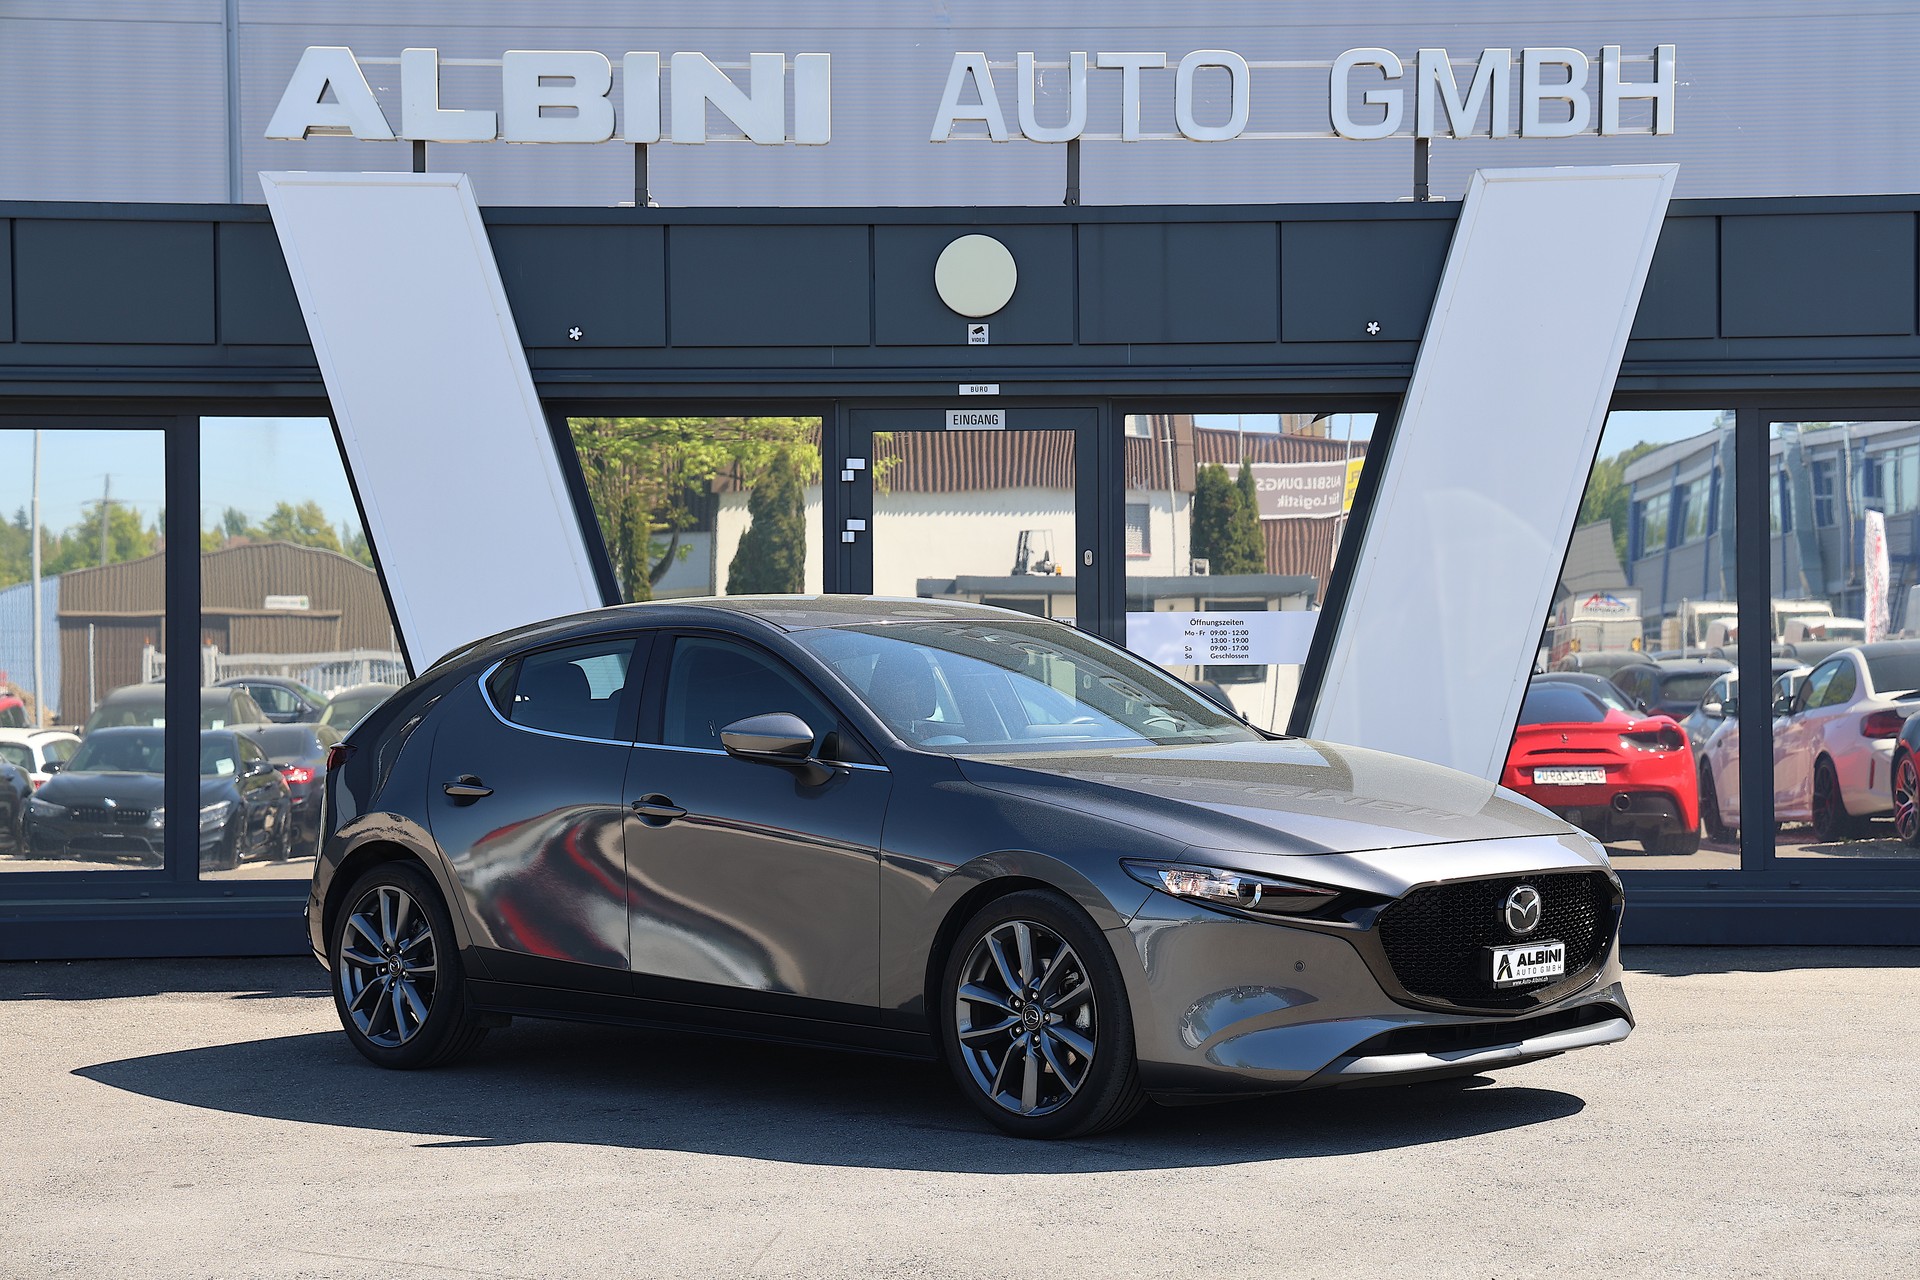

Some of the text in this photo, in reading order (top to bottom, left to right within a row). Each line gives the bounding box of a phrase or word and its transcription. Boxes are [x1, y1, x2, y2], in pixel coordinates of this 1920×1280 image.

[264, 44, 1677, 146] ALBINI AUTO GMBH
[953, 413, 999, 426] EINGANG
[1189, 618, 1244, 627] Öffnungszeiten
[1516, 948, 1562, 967] ALBINI
[1516, 964, 1562, 976] AUTO GMBH
